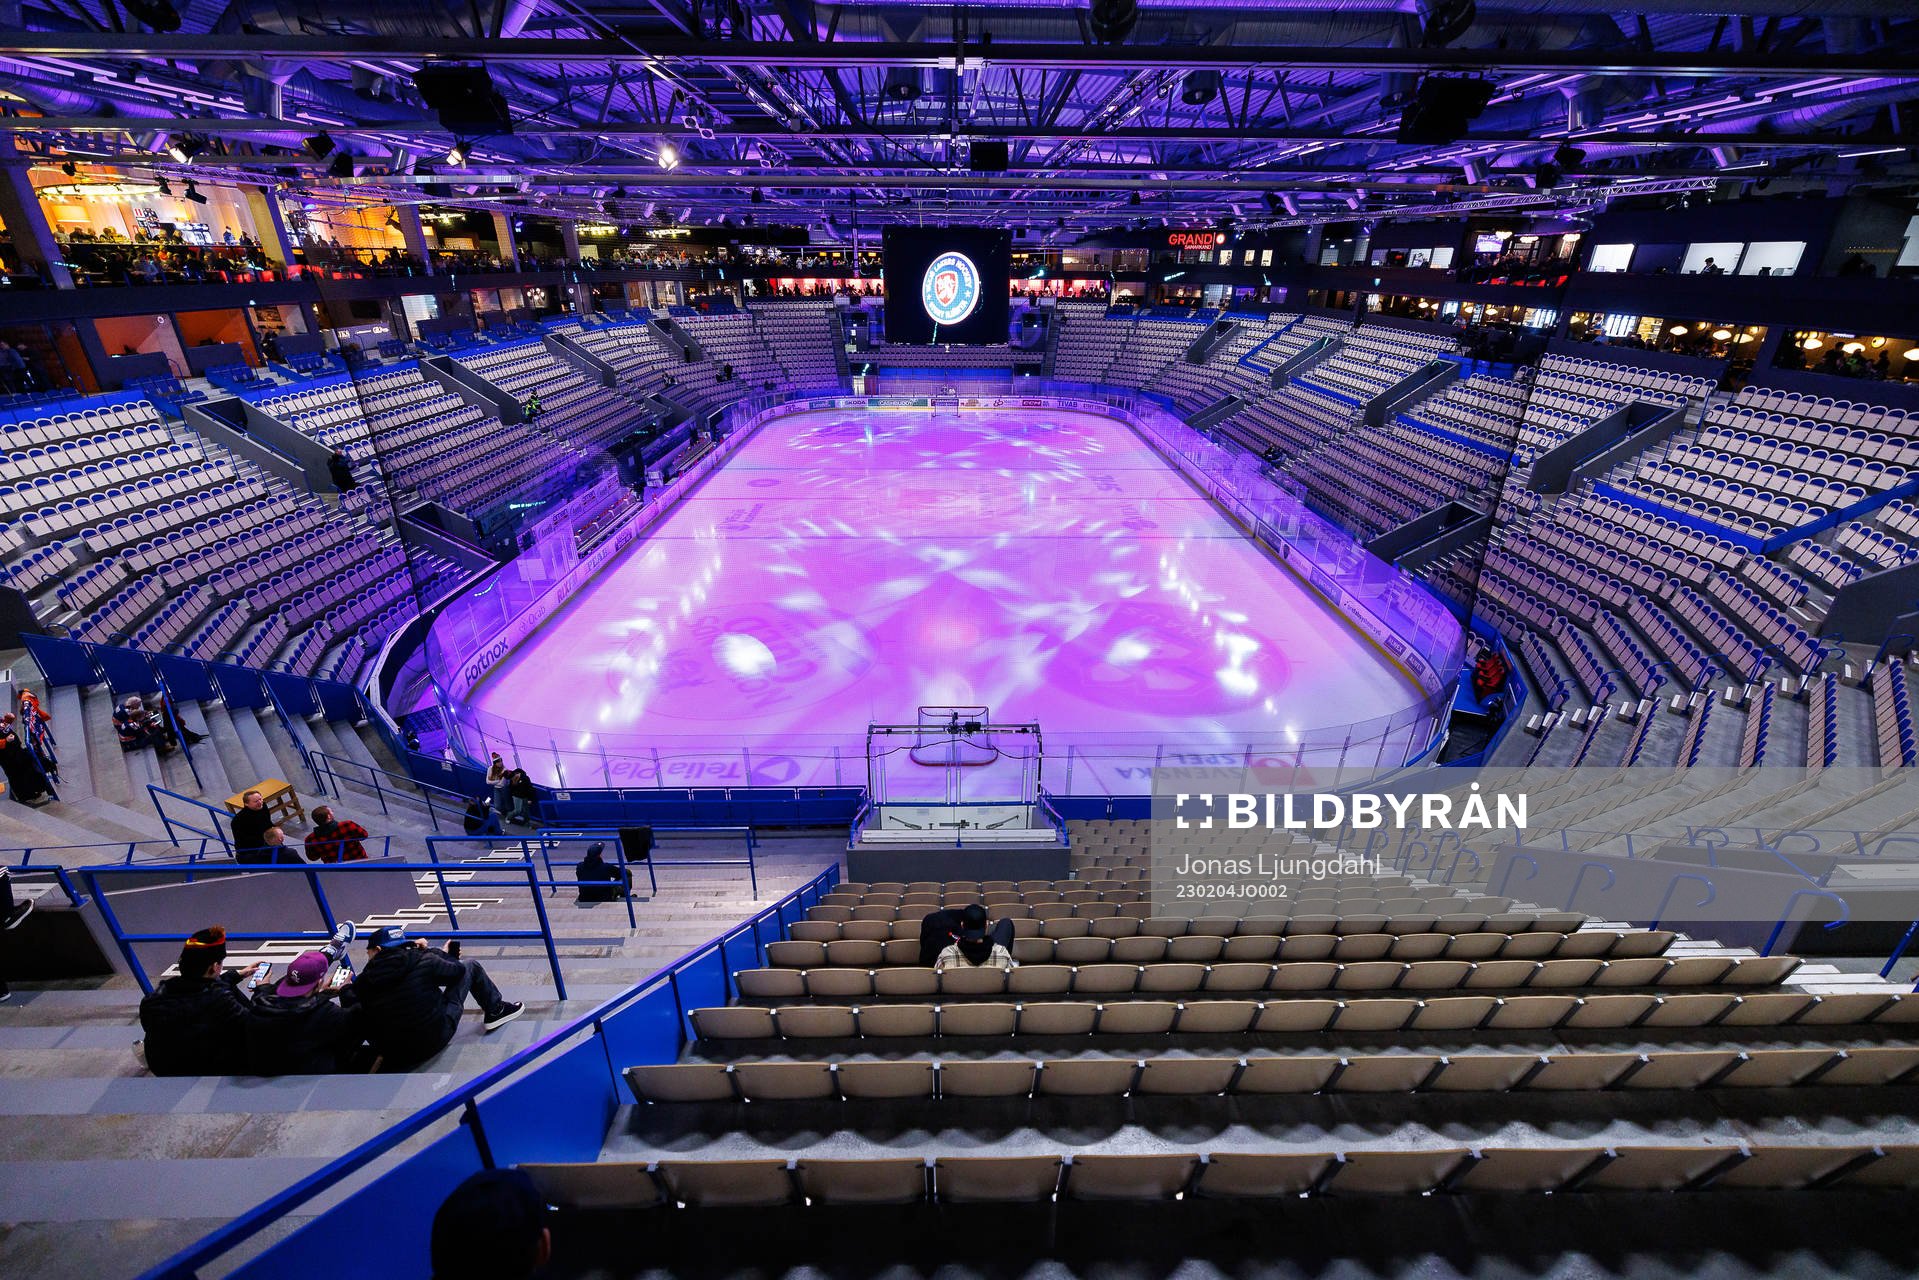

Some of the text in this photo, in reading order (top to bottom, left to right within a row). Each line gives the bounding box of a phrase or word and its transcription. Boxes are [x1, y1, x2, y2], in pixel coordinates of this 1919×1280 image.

[1168, 233, 1213, 245] GRAND
[1057, 400, 1078, 408] TIVAB
[591, 759, 742, 780] Telia Play
[1115, 767, 1243, 780] SVENSKA
